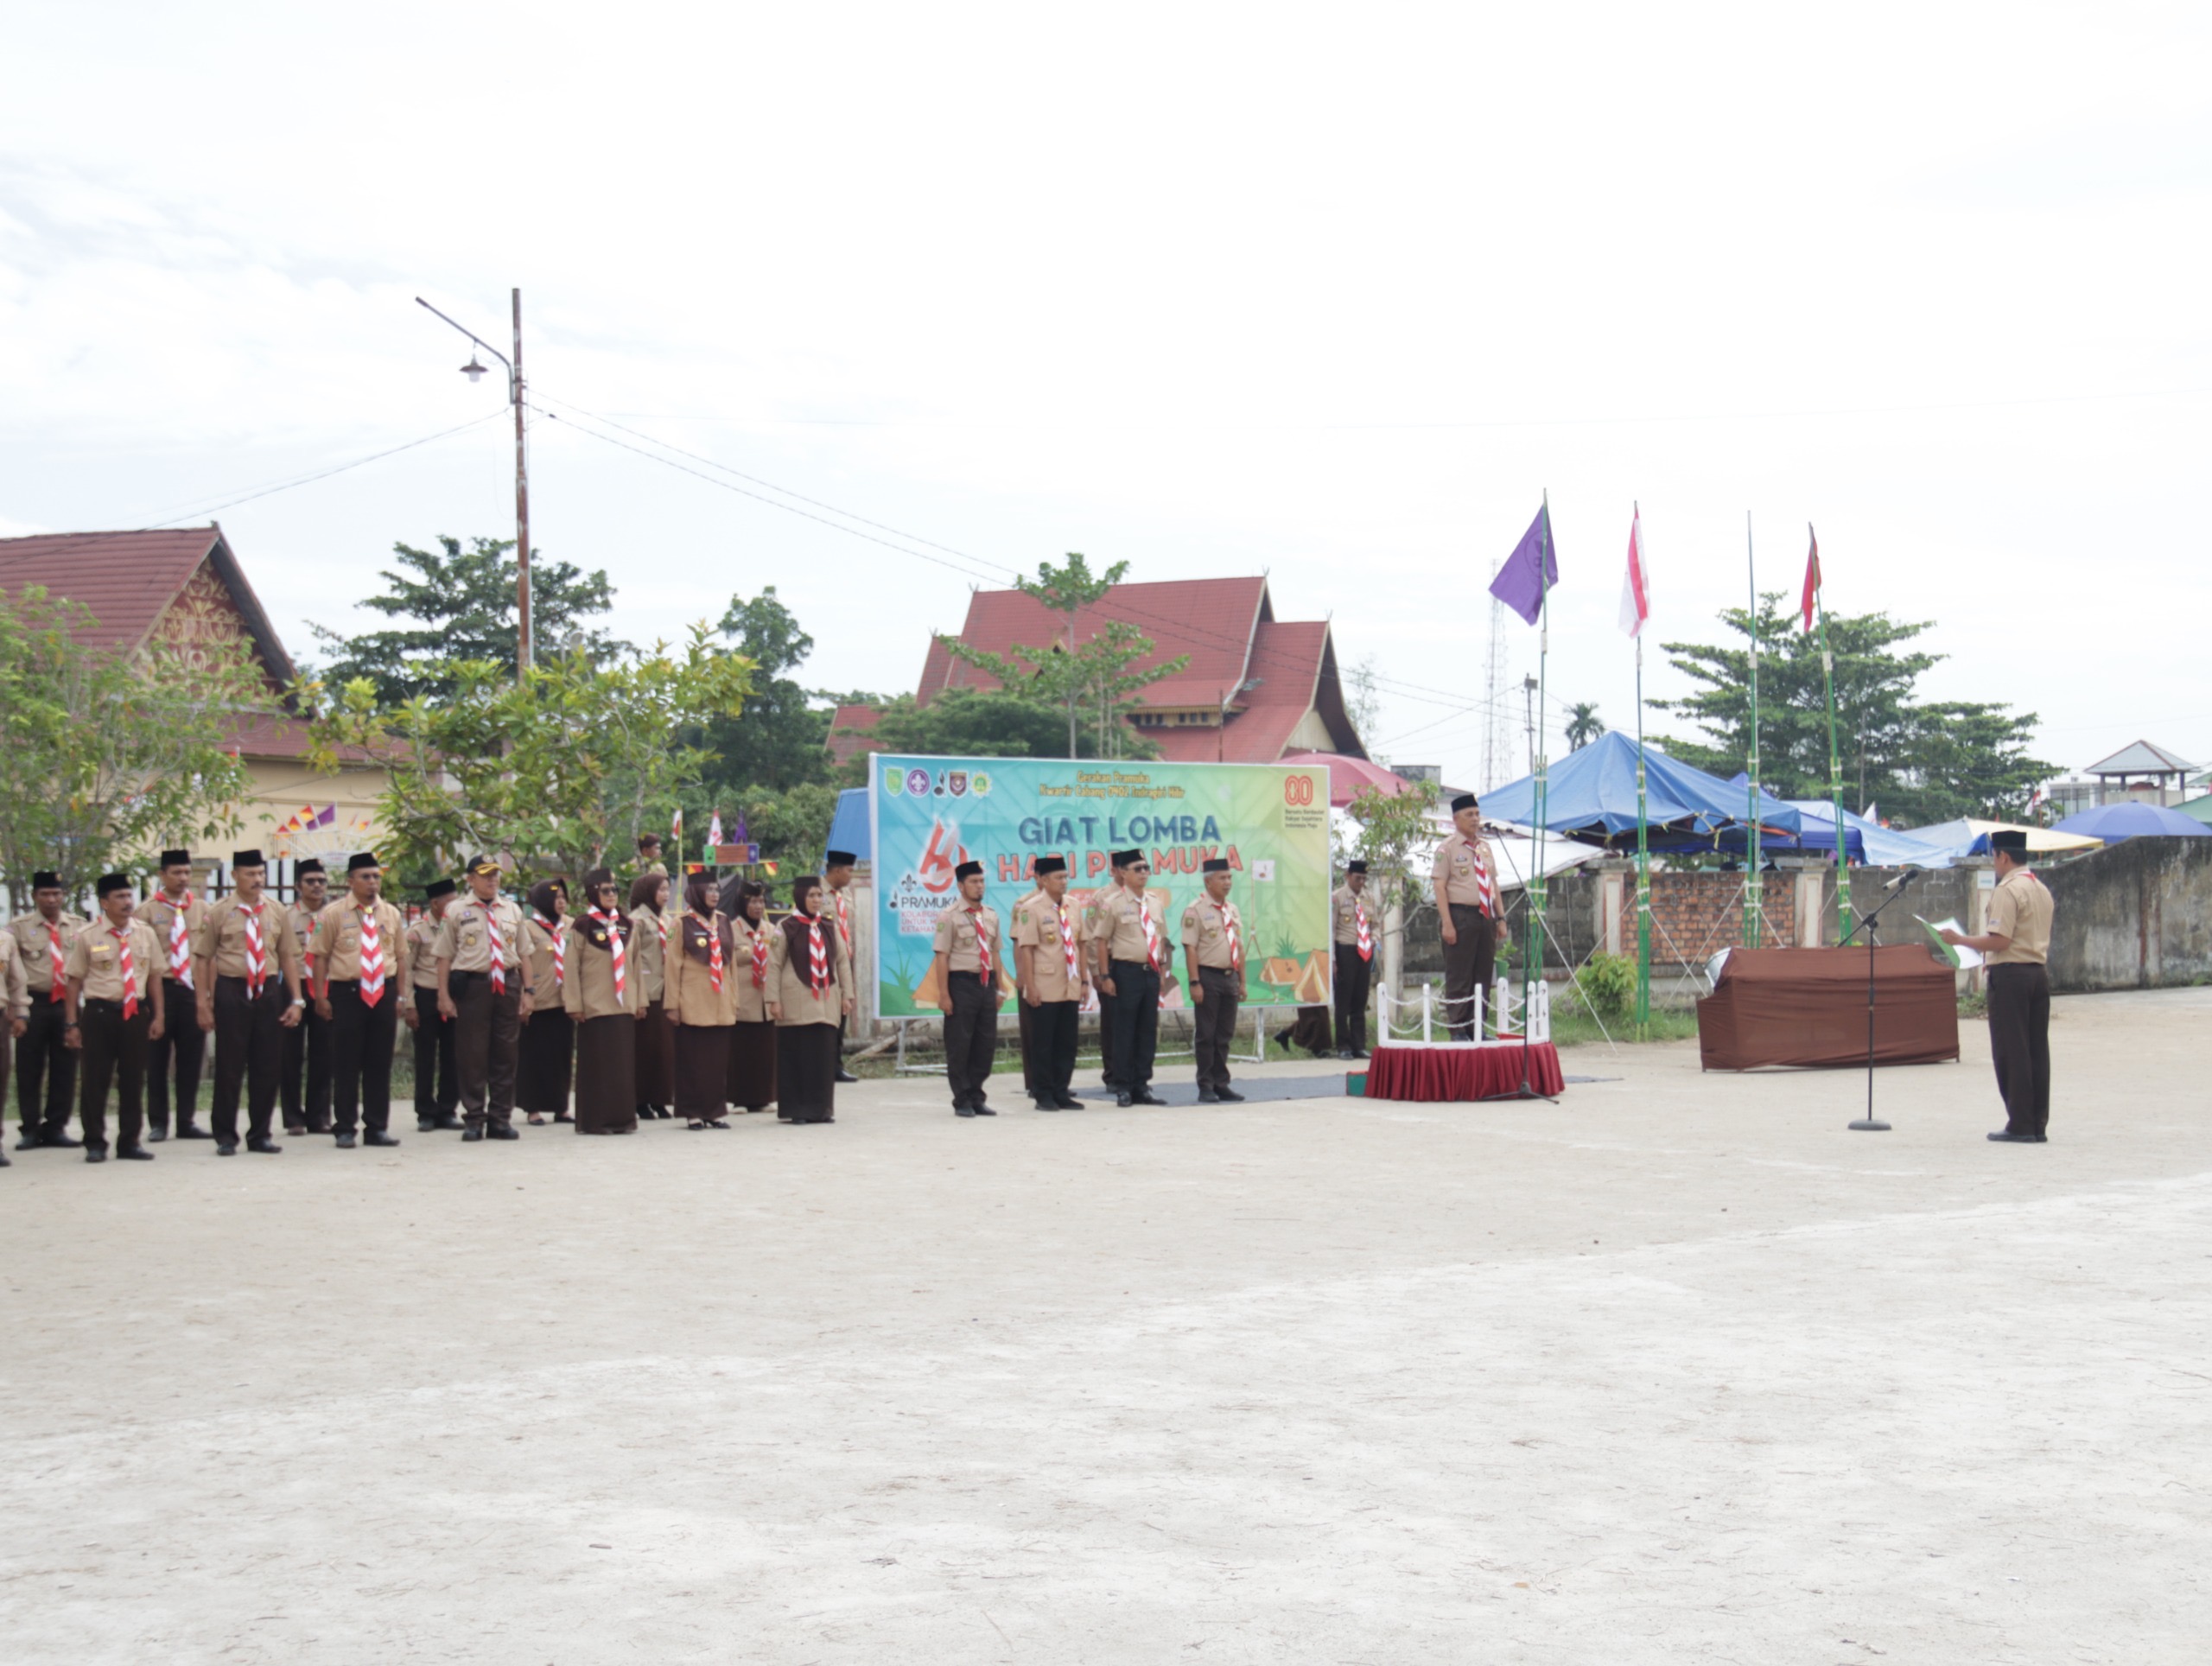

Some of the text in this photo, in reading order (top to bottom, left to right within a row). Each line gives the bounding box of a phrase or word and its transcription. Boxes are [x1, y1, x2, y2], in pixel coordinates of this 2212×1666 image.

[1039, 784, 1073, 797] Kwartir
[1076, 785, 1106, 800] Cabang
[1131, 785, 1166, 800] Indragiri
[1077, 771, 1150, 785] Gerakan Pramuka
[1284, 774, 1313, 806] 80
[1018, 815, 1222, 845] GIAT LOMBA
[997, 844, 1243, 882] HAI PMUKA
